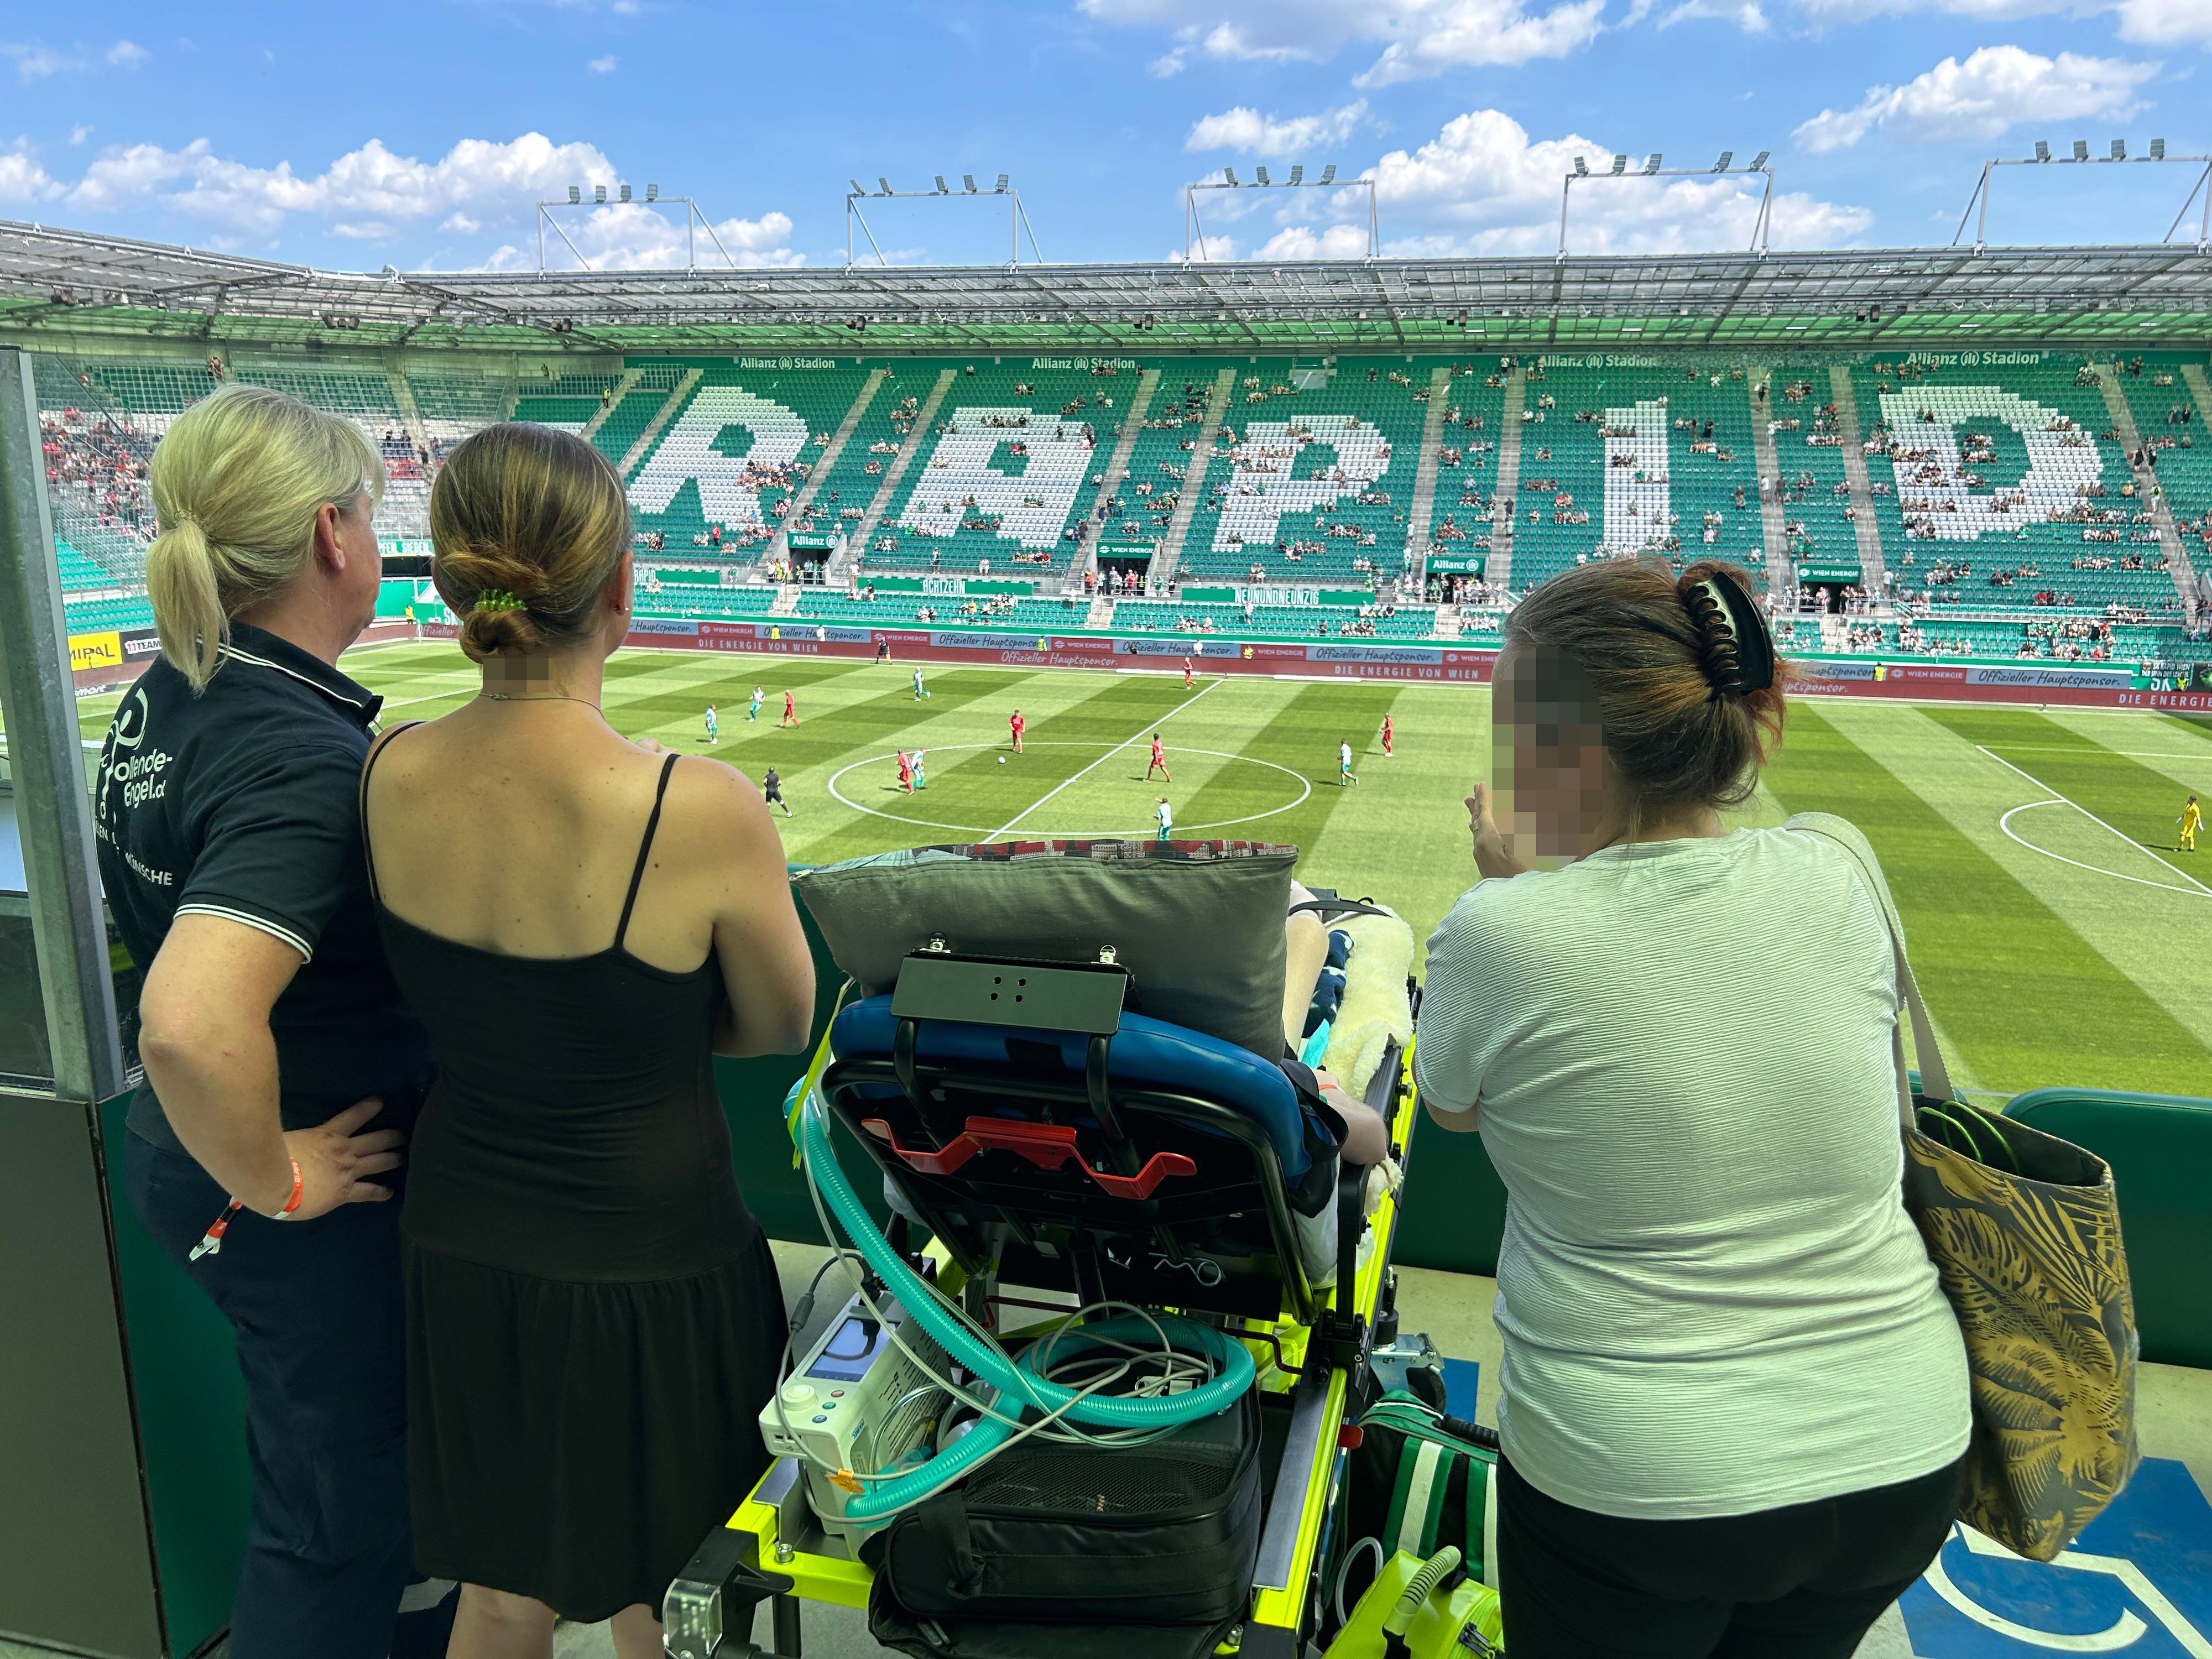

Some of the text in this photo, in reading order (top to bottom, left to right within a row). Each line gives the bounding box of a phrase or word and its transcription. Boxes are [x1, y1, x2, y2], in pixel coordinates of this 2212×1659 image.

[740, 357, 836, 369] Allianz Stadion
[1032, 357, 1135, 369] Allianz Stadion
[1542, 355, 1584, 367] Allianz
[1906, 352, 2039, 365] Allianz Stadion
[401, 541, 429, 554] SIEGEN
[792, 535, 825, 546] Allianz
[1432, 559, 1466, 570] Allianz
[634, 569, 656, 583] RAPID
[923, 580, 966, 594] ACHTZEHN
[1234, 589, 1319, 605] NEUNUNDNEUNZIG
[635, 619, 691, 634] Hauptsponsor.
[698, 639, 818, 653] DIE ENERGIE VON WIEN
[940, 634, 1037, 649] Offizieller Hauptsponso
[1168, 642, 1233, 656] Hauptponsor.
[1316, 648, 1434, 664] Offizieller Hauptsponsor.
[1001, 651, 1119, 668] Offizieller Hauptsponsor.
[1334, 665, 1479, 679] DIE ENERGIE VON WIEN
[1978, 670, 2121, 688] Offizieller Hauptsponsor.
[2119, 693, 2212, 708] DIE ENERGIE
